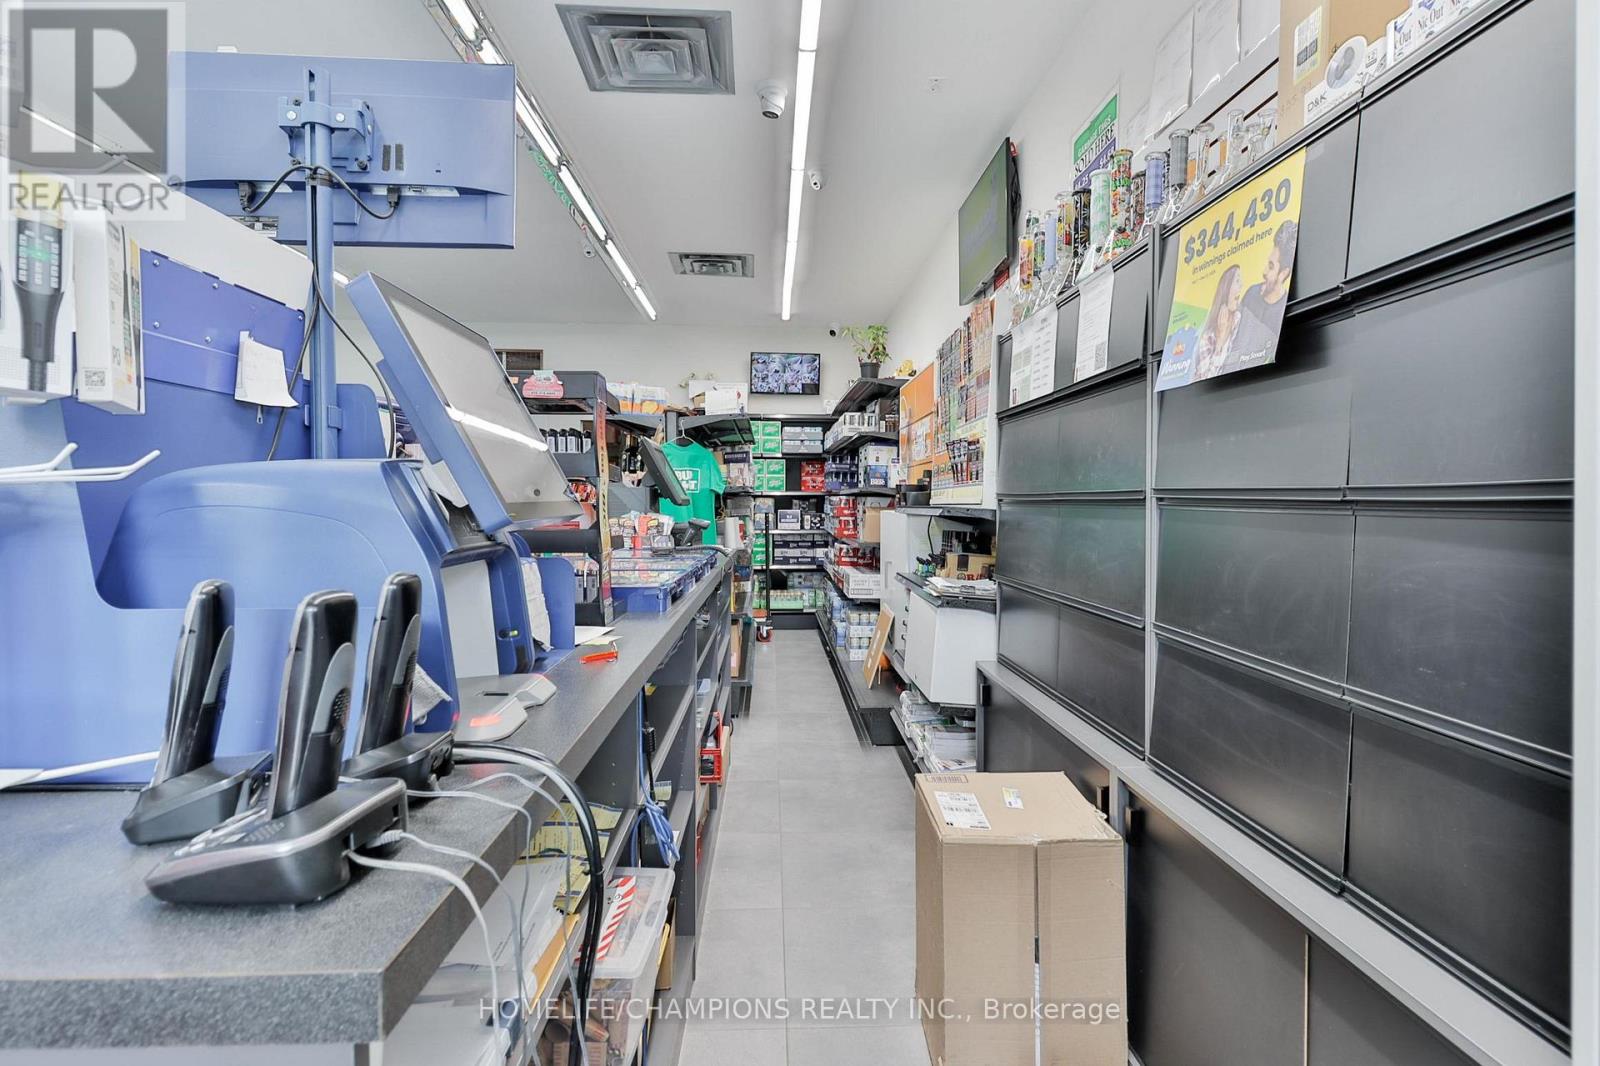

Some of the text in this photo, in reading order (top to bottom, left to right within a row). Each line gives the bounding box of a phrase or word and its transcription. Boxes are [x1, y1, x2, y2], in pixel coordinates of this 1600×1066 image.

[1183, 177, 1292, 265] $344,430
[1198, 251, 1226, 273] winnings
[1226, 234, 1255, 257] claimed
